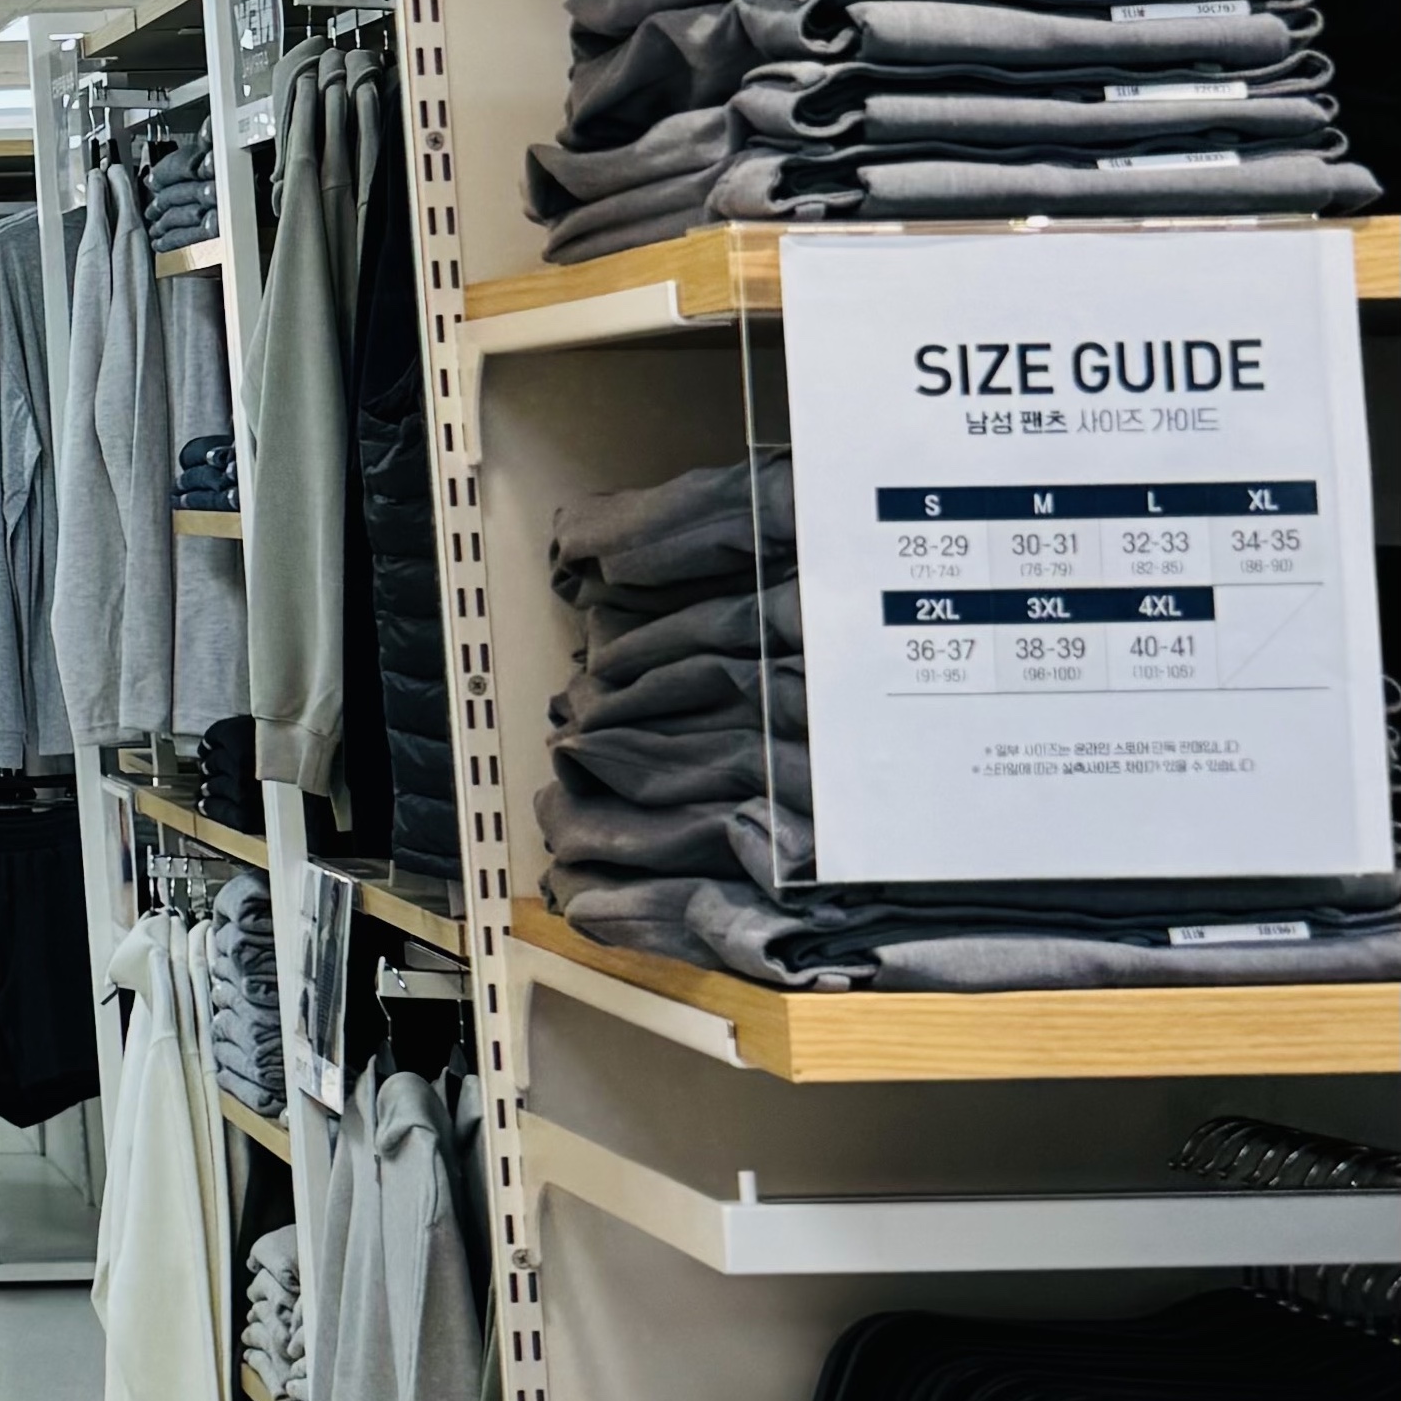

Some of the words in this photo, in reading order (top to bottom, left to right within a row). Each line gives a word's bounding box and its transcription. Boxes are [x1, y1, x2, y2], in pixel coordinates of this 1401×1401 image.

[914, 342, 1055, 397] SIZE
[1072, 338, 1265, 394] GUIDE
[966, 410, 1014, 436] 남성
[1020, 408, 1069, 435] 팬츠
[1077, 408, 1145, 434] 사이즈
[1152, 406, 1220, 433] 가이드
[924, 493, 942, 517] S
[1033, 492, 1055, 515] M
[1147, 490, 1163, 513] L
[1247, 487, 1280, 512] XL
[897, 535, 969, 557] 28-29
[1011, 533, 1079, 556] 30-31
[1122, 531, 1190, 554] 32-33
[1231, 529, 1301, 552] 34-35
[909, 564, 961, 579] (71-74)
[915, 597, 961, 621] 2XL
[1026, 596, 1071, 619] 3XL
[1137, 594, 1183, 617] 4XL
[905, 639, 976, 661] 36-37
[1015, 637, 1086, 660] 38-39
[1129, 634, 1196, 657] 40-41
